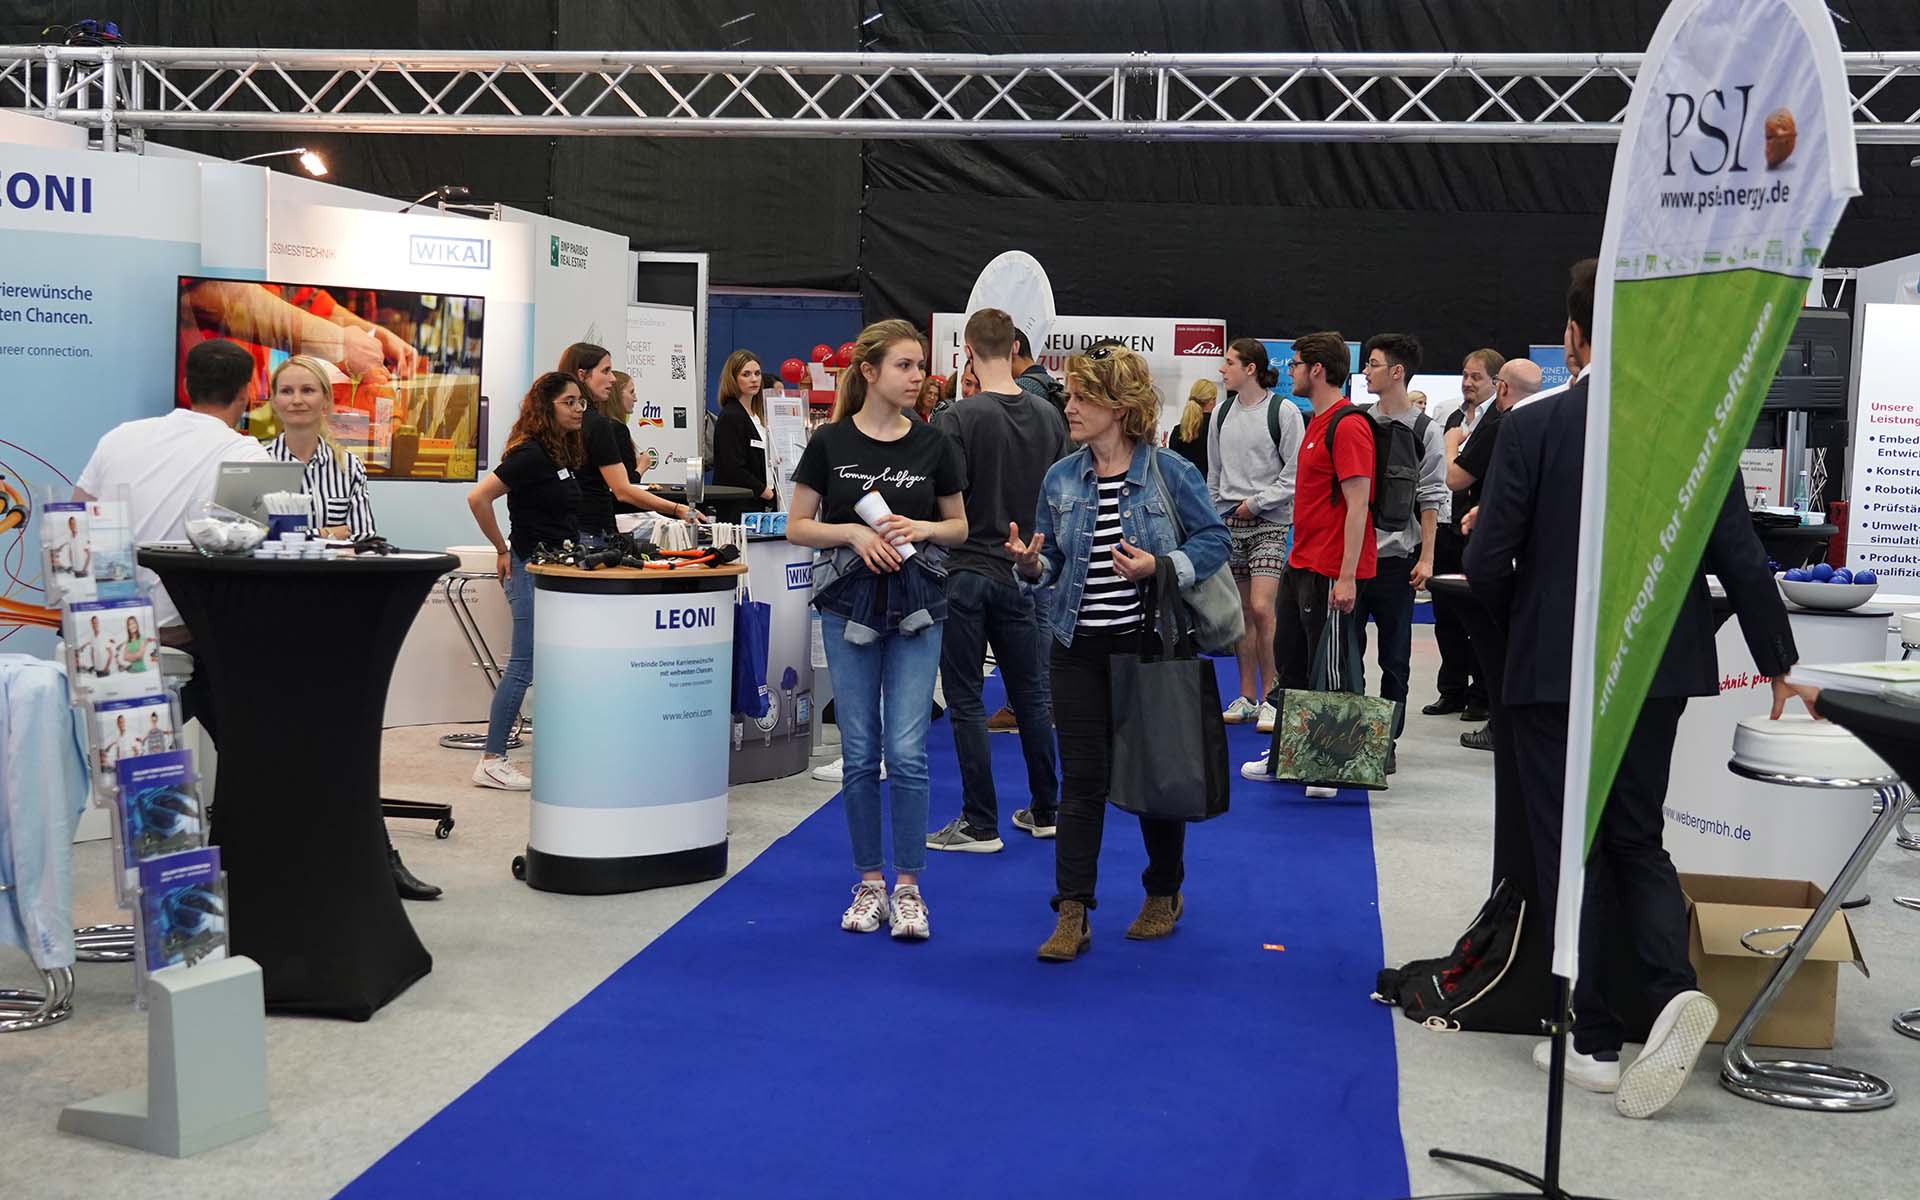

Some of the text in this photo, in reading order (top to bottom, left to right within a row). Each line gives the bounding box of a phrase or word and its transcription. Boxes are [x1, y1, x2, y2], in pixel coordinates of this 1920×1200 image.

[1663, 85, 1754, 176] PSI
[0, 172, 92, 213] ONI
[269, 242, 337, 259] SSMESSTECHNIK
[416, 242, 478, 263] WIKA
[561, 241, 588, 257] BNP PARIBAS
[561, 254, 587, 269] REAL ESTATE
[26, 307, 93, 325] Chancen.
[1081, 334, 1154, 352] DKEN
[1183, 341, 1223, 355] Linde
[27, 346, 93, 358] connection.
[642, 401, 661, 418] dm
[1871, 403, 1914, 413] Unsere
[1878, 435, 1920, 445] Embed
[833, 464, 880, 490] Tommy
[1624, 554, 1664, 639] People
[1658, 509, 1682, 553] for
[1678, 426, 1719, 512] Smart
[1714, 301, 1773, 429] Software
[1870, 535, 1920, 546] simulati
[655, 607, 715, 629] LEONI
[662, 709, 713, 720] www.leoni.com
